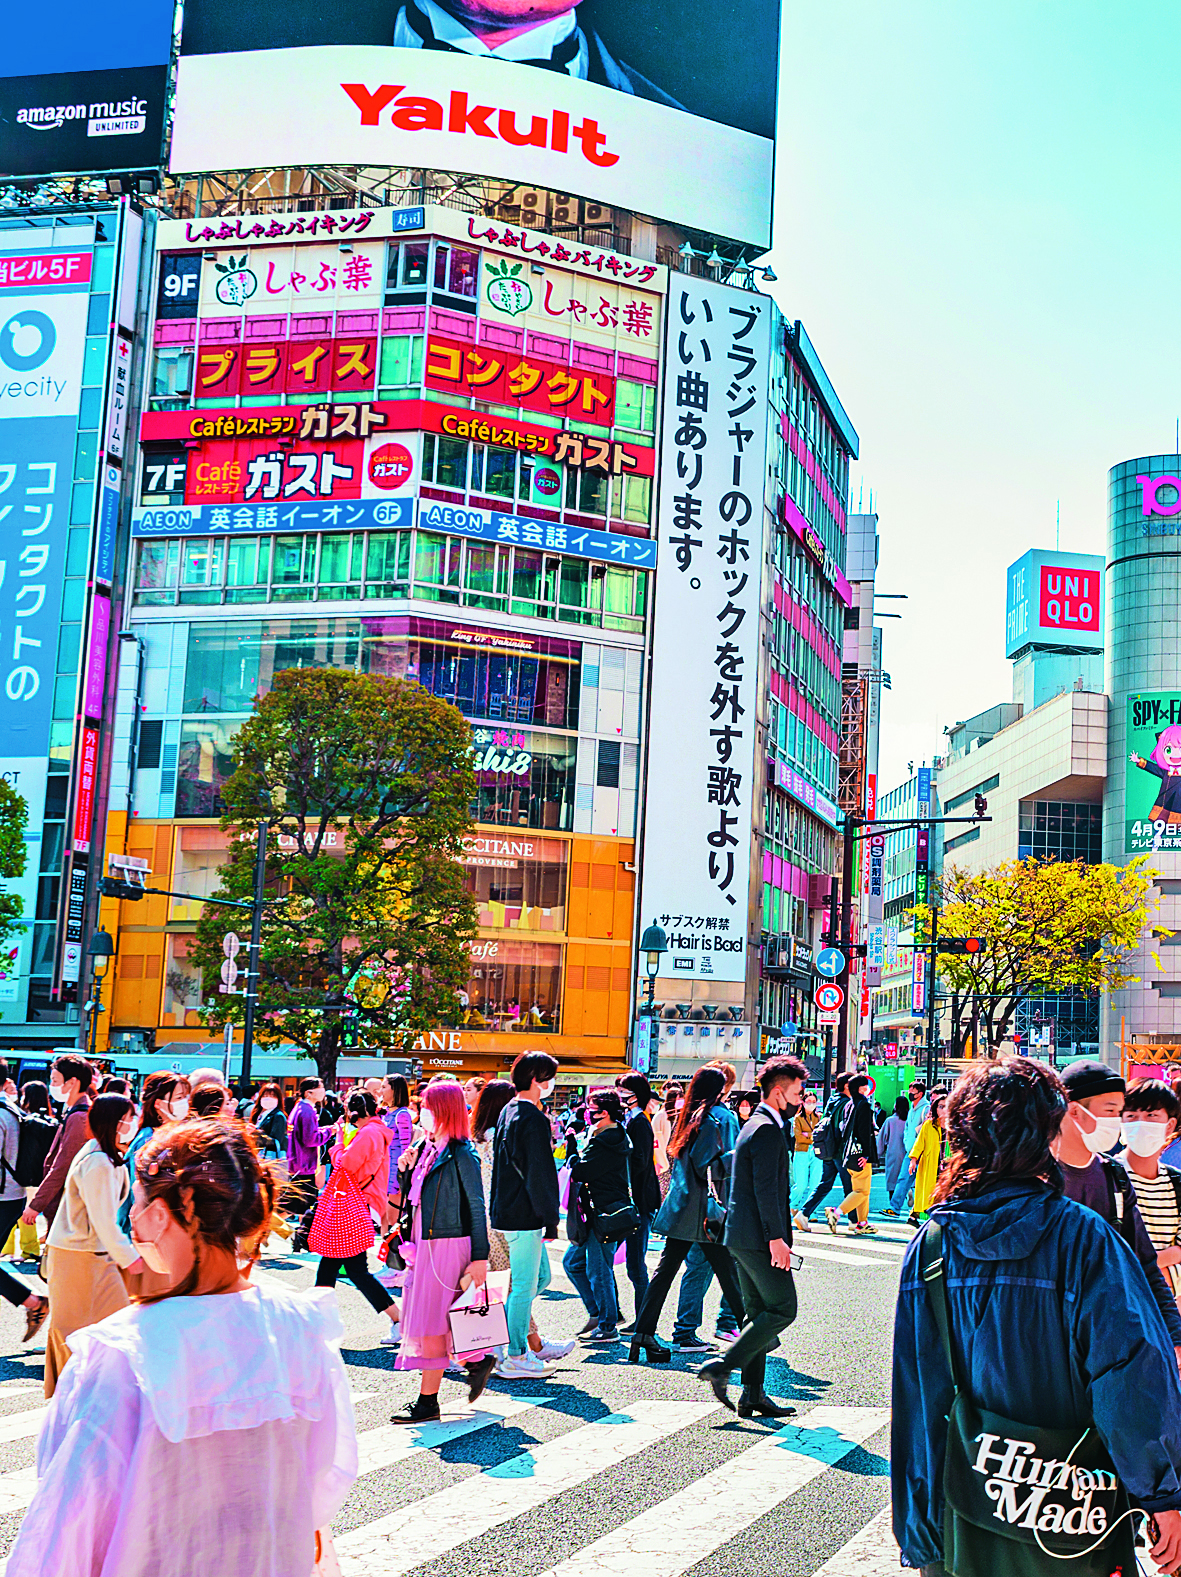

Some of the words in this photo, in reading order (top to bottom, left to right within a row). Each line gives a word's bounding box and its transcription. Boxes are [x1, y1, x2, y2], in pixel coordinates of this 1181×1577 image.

[17, 105, 86, 124] amazon
[89, 96, 147, 118] music
[95, 121, 139, 132] UNLIMITED
[341, 84, 620, 167] Yakult
[185, 211, 375, 242] しゃぶしゃぶバイキング
[468, 217, 658, 283] しゃぶしゃぶバイキング
[164, 274, 198, 297] 9F
[265, 255, 373, 294] しゃぶ葉
[543, 280, 653, 337] しゃぶ葉
[200, 343, 374, 390] プライス
[427, 343, 611, 414] コンタクト
[300, 403, 386, 439] ガスト
[553, 431, 638, 476] ガスト
[668, 290, 713, 590] いい曲あります。
[146, 464, 187, 491] 7F
[195, 460, 241, 483] Café
[195, 481, 241, 495] レストラン
[245, 453, 353, 500] ガスト
[373, 463, 409, 478] ガスト
[142, 511, 191, 529] AEON
[209, 505, 364, 531] 英会話イーオン
[375, 505, 400, 520] 6F
[428, 507, 483, 531] AEON
[497, 517, 652, 561] 英会話イーオン
[6, 462, 57, 701] コンタクトの
[1011, 566, 1026, 607] THE
[1047, 573, 1090, 598] UNI
[707, 304, 762, 905] ブラジャーのホックを外す歌より、
[1007, 599, 1029, 645] PRIME
[1047, 602, 1093, 624] QLO
[88, 703, 99, 714] 4F
[474, 728, 526, 750] 谷焼肉
[82, 730, 97, 791] 外貨両替
[75, 841, 87, 851] 7F
[467, 857, 515, 867] PROVENCE
[660, 914, 730, 931] サブスク解禁
[671, 933, 700, 950] Hair
[701, 934, 712, 951] is
[714, 935, 743, 953] Bad
[874, 926, 883, 964] 渋谷駅前
[676, 960, 692, 968] EMI
[972, 1433, 1118, 1500] Human
[984, 1479, 1107, 1535] Made
